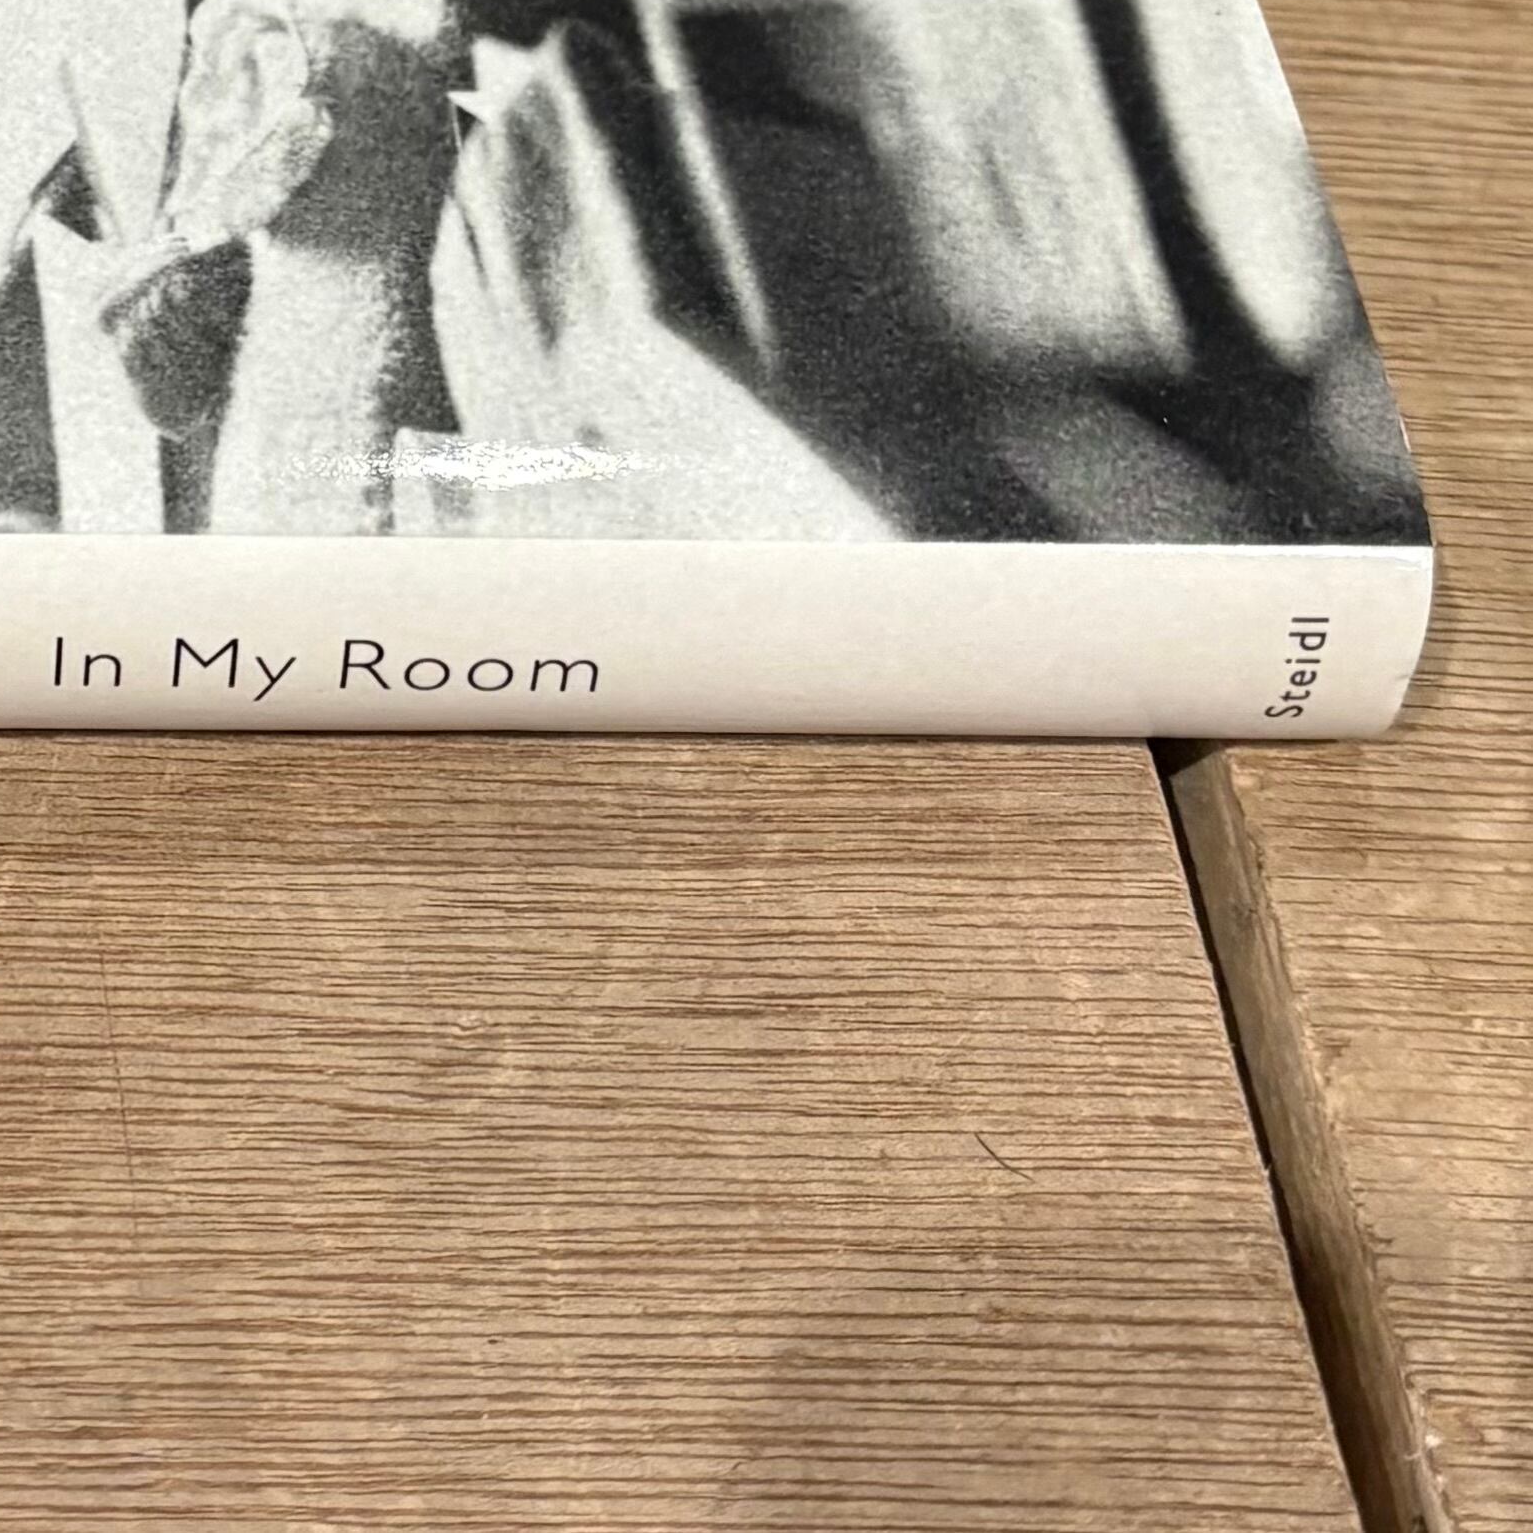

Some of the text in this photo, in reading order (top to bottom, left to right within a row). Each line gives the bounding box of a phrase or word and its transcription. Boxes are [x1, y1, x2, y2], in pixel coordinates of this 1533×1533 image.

[54, 636, 122, 687] In
[171, 637, 297, 701] My
[339, 639, 599, 692] Room
[1264, 617, 1329, 718] Steidl
